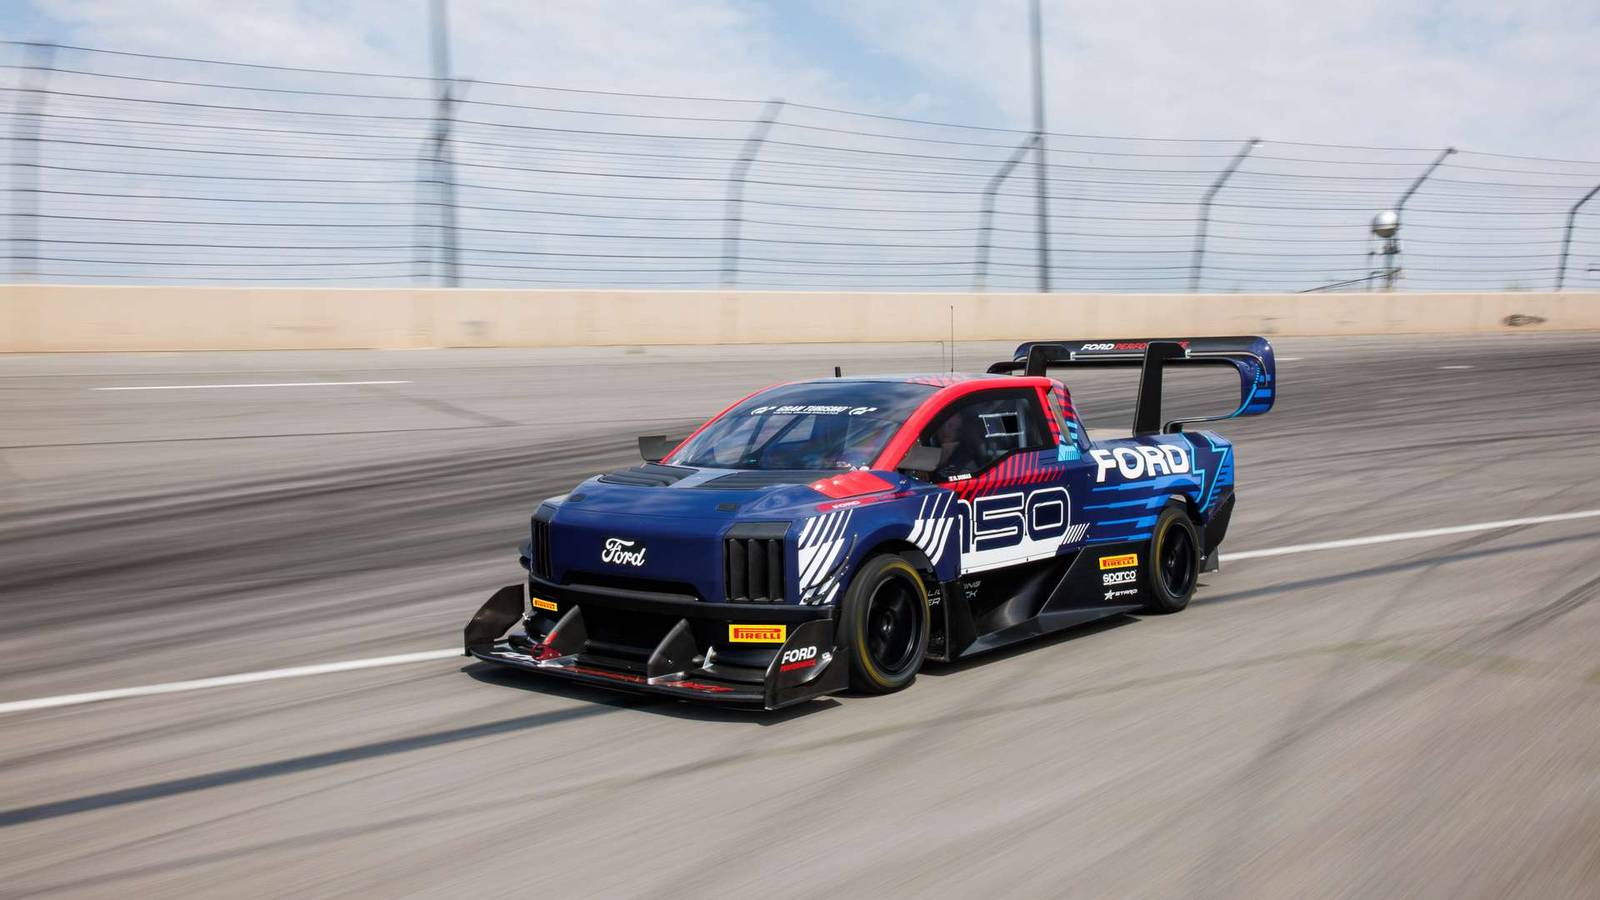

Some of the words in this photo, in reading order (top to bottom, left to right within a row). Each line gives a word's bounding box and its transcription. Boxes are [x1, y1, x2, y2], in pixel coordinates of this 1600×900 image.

[1081, 343, 1115, 351] FORD
[1089, 444, 1190, 482] FORD
[601, 538, 646, 566] Ford
[1102, 556, 1135, 567] PIRELLI
[1102, 570, 1137, 585] sparco
[733, 628, 781, 640] PIRELLI
[781, 646, 818, 664] FORD
